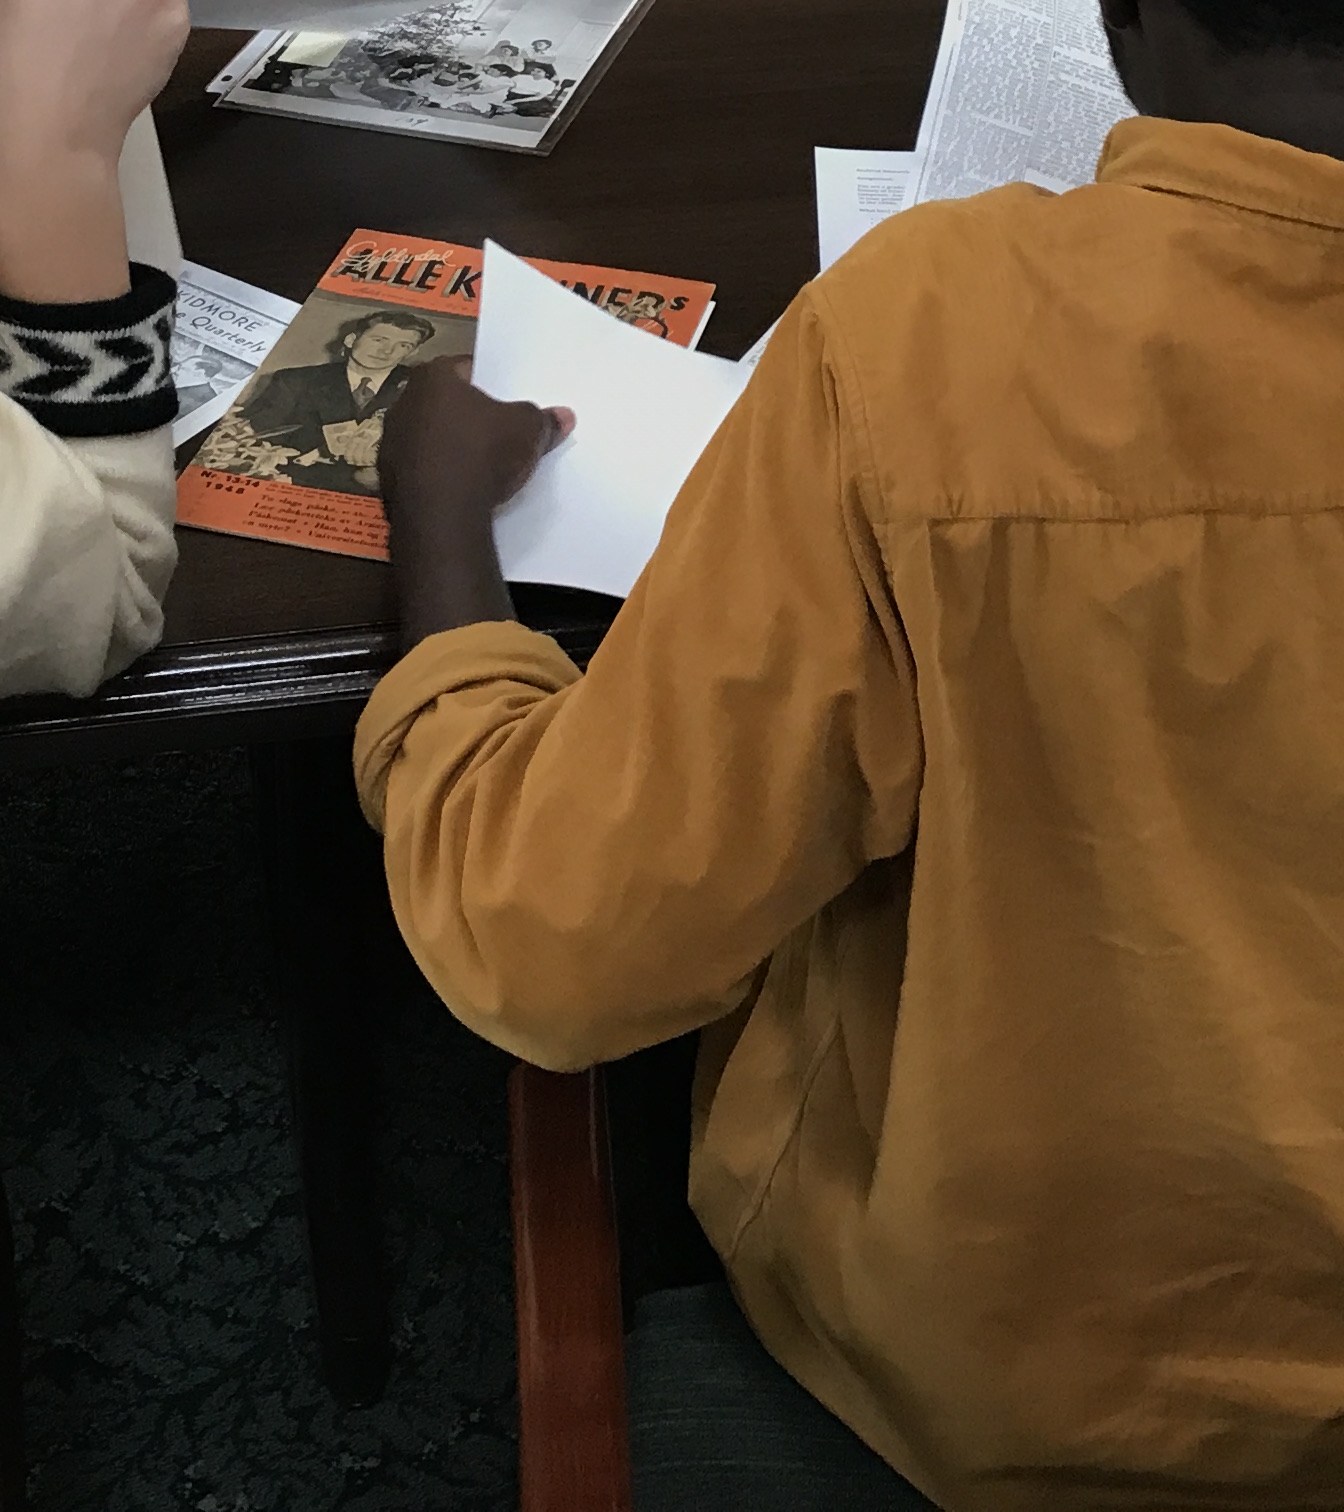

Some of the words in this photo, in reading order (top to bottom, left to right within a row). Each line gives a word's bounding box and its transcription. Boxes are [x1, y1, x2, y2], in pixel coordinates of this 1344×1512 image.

[331, 248, 446, 294] ALLE
[189, 316, 267, 353] Quarterly
[205, 481, 246, 495] 1948
[225, 474, 261, 488] 13-14
